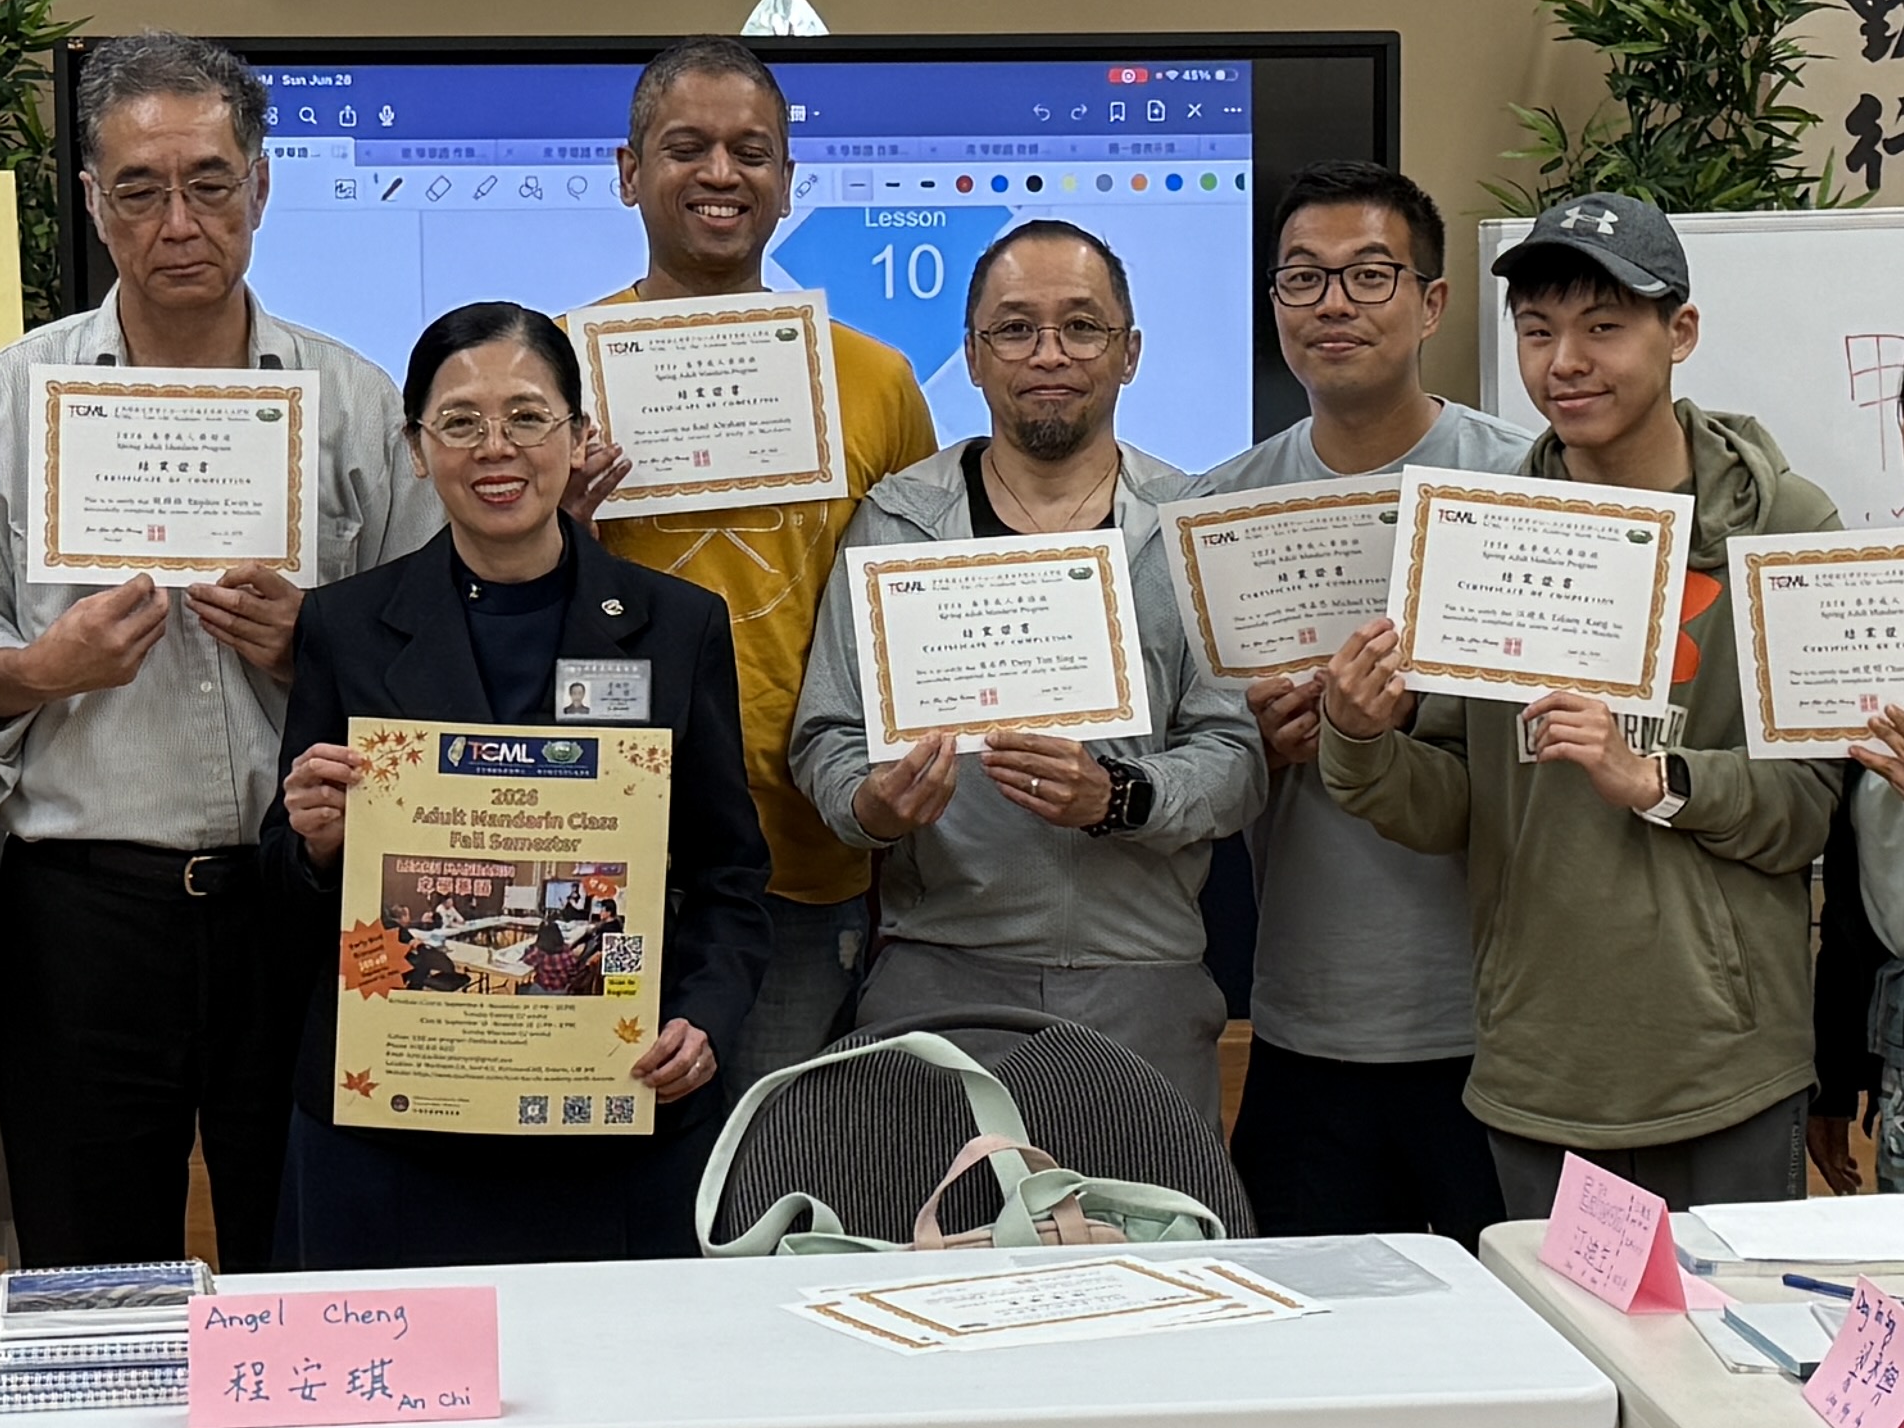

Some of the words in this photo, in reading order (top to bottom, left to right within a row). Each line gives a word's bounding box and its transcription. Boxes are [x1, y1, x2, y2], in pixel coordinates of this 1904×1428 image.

[282, 75, 306, 86] Sun
[309, 75, 332, 86] Jun
[864, 207, 947, 229] Lesson
[871, 243, 944, 300] 10
[468, 741, 535, 764] TCML
[412, 806, 467, 826] Adult
[471, 809, 564, 830] Mandarin
[205, 1300, 285, 1330] Angel
[323, 1303, 409, 1340] Cheng
[398, 1394, 425, 1411] An
